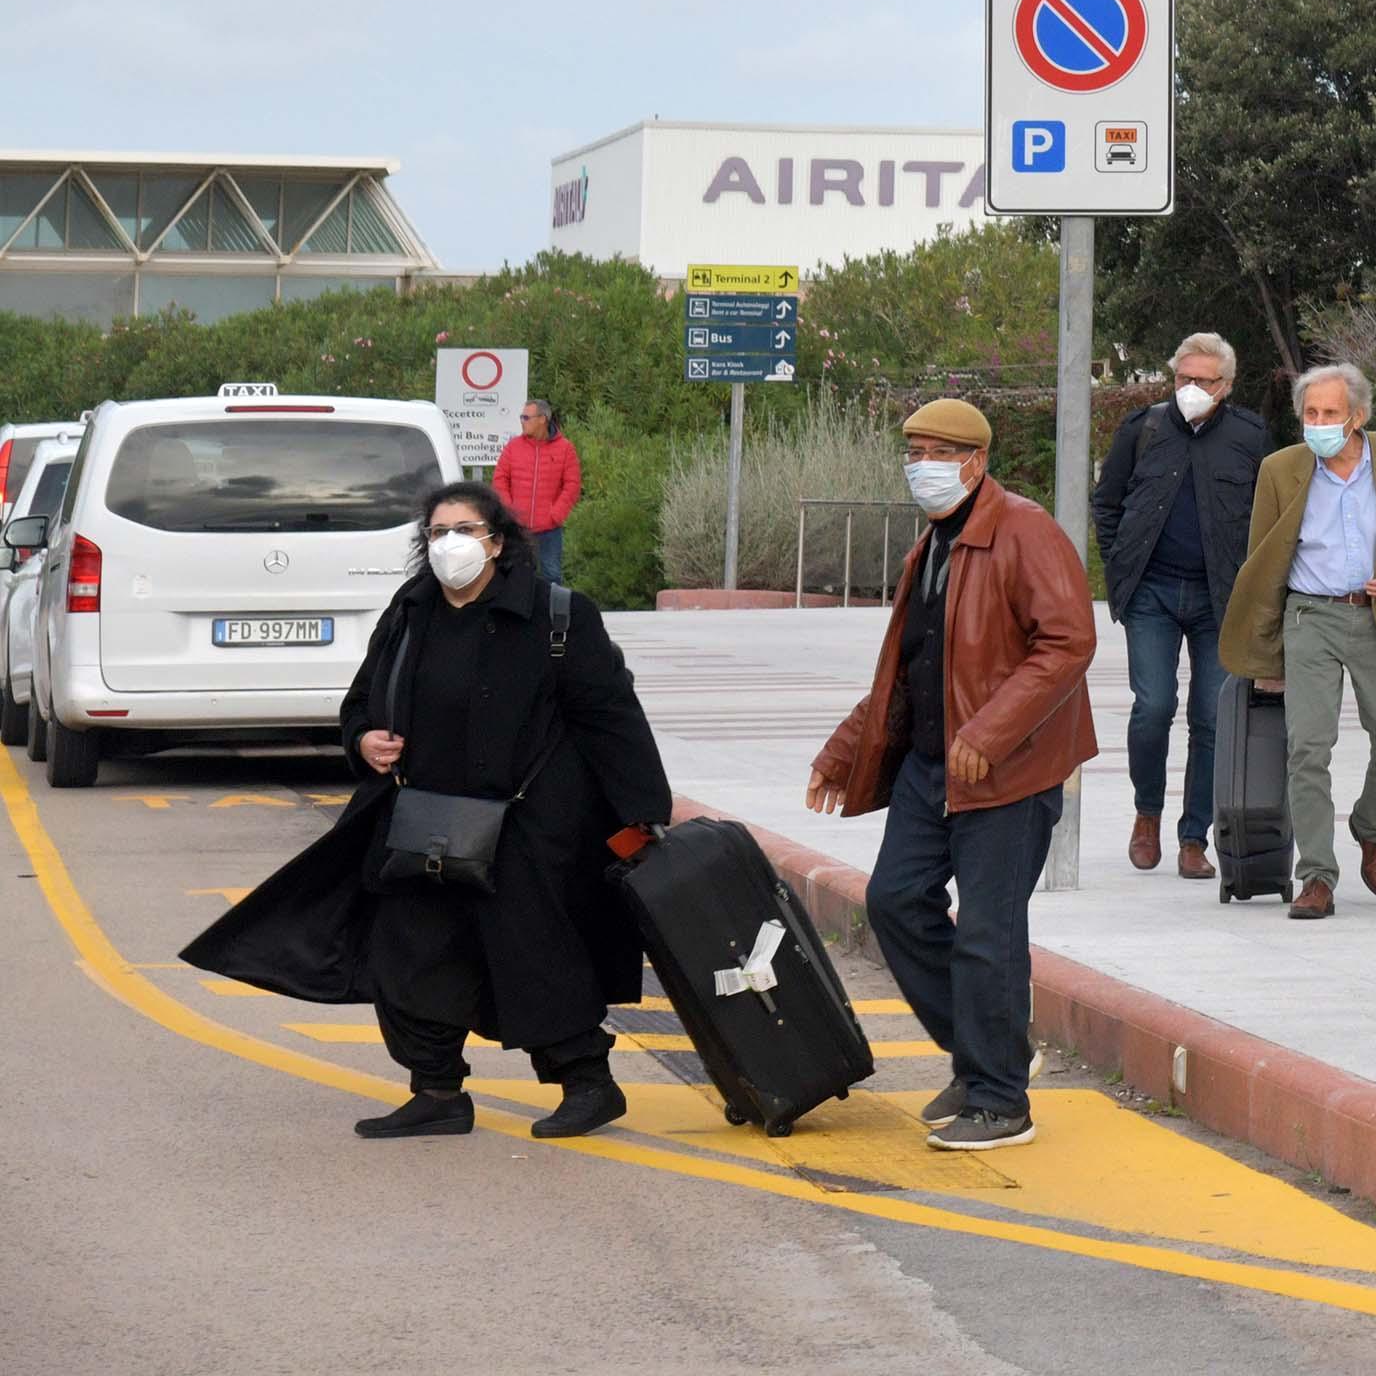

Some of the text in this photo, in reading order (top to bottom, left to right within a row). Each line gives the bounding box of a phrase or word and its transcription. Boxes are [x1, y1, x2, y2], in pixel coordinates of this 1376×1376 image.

[1109, 131, 1135, 140] TAXI
[1024, 127, 1053, 165] P
[715, 274, 771, 284] Terminal 2
[711, 333, 733, 343] Bus
[226, 386, 272, 397] TAXI
[465, 431, 484, 439] Bus
[228, 622, 319, 640] FD 997MM
